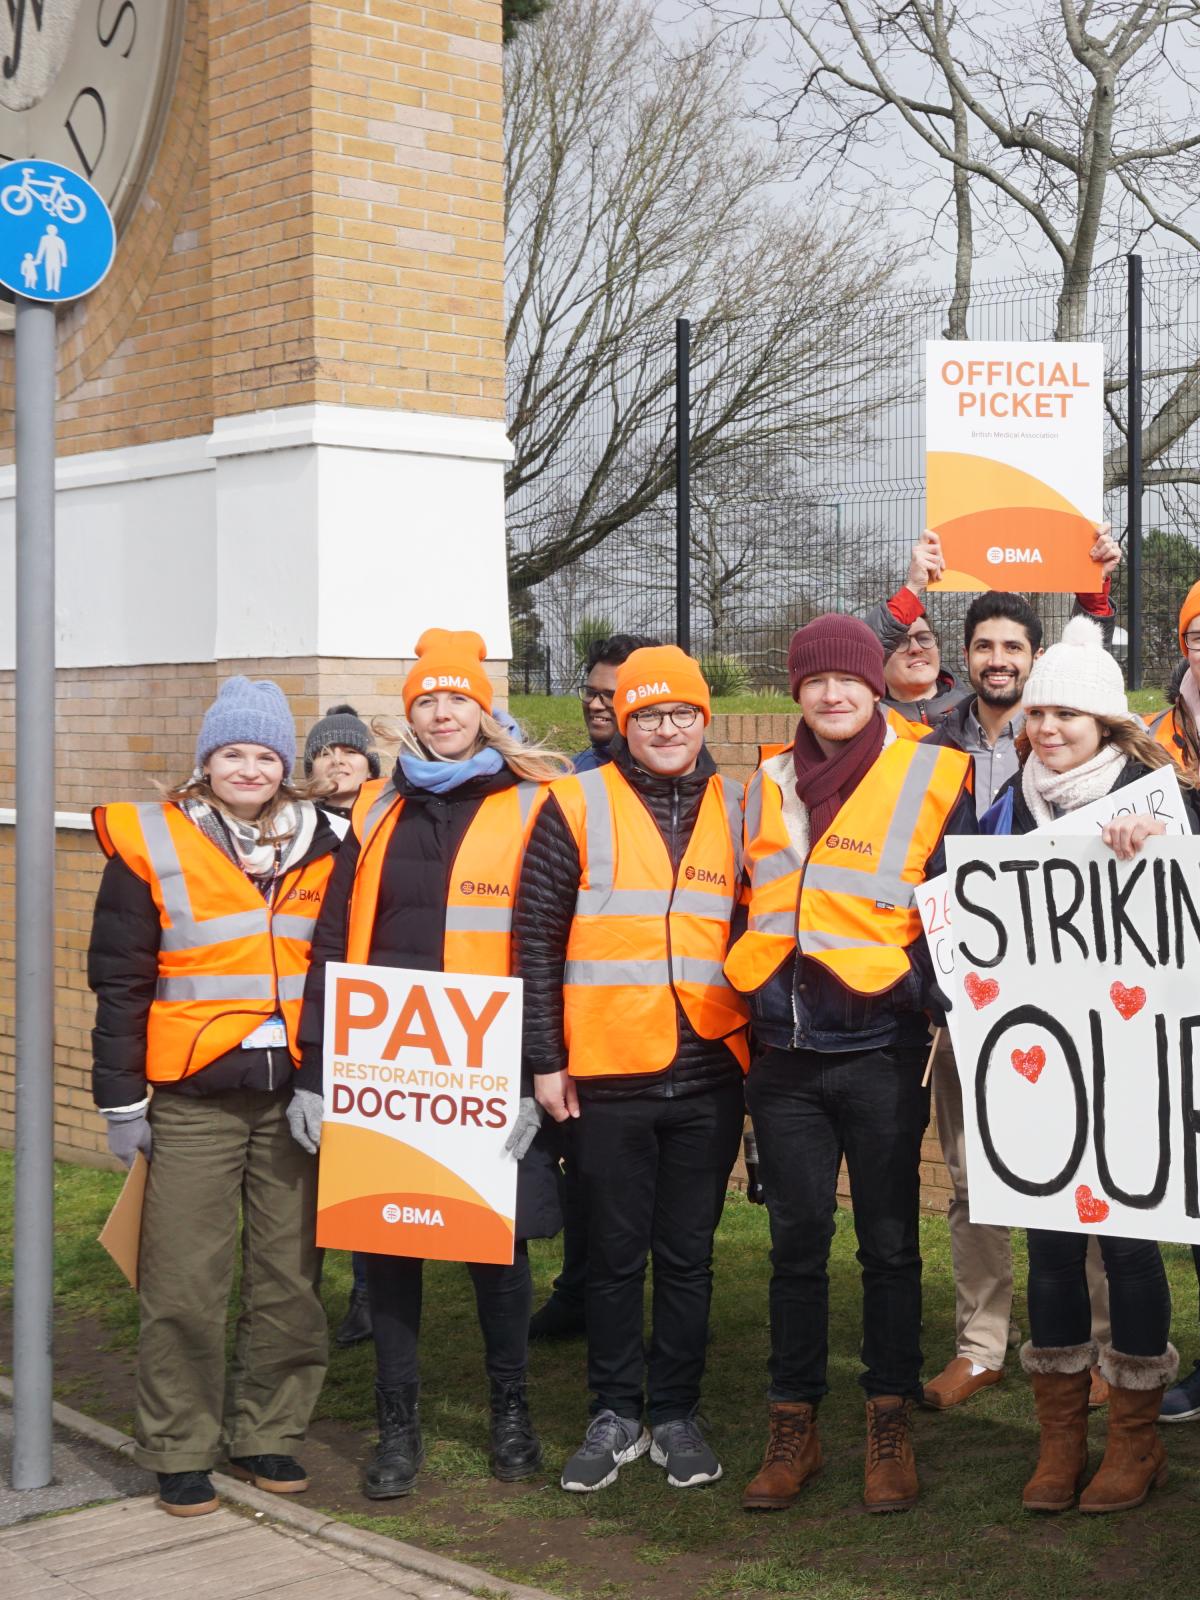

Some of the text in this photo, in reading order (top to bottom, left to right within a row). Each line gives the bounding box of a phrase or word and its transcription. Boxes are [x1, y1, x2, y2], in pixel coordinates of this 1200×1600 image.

[941, 360, 1090, 387] OFFICIAL
[958, 392, 1074, 418] PICKET
[971, 431, 1059, 439] British Medical Association
[1005, 548, 1043, 563] BMA
[438, 675, 471, 690] BMA
[637, 681, 671, 698] BMA
[840, 837, 873, 856] BMA
[697, 869, 727, 886] BMA
[299, 889, 321, 903] BMA
[477, 882, 510, 897] BMA
[334, 977, 511, 1069] PAY
[333, 1061, 509, 1092] RESTORATION FOR
[332, 1083, 508, 1129] DOCTORS
[402, 1207, 444, 1226] BMA
